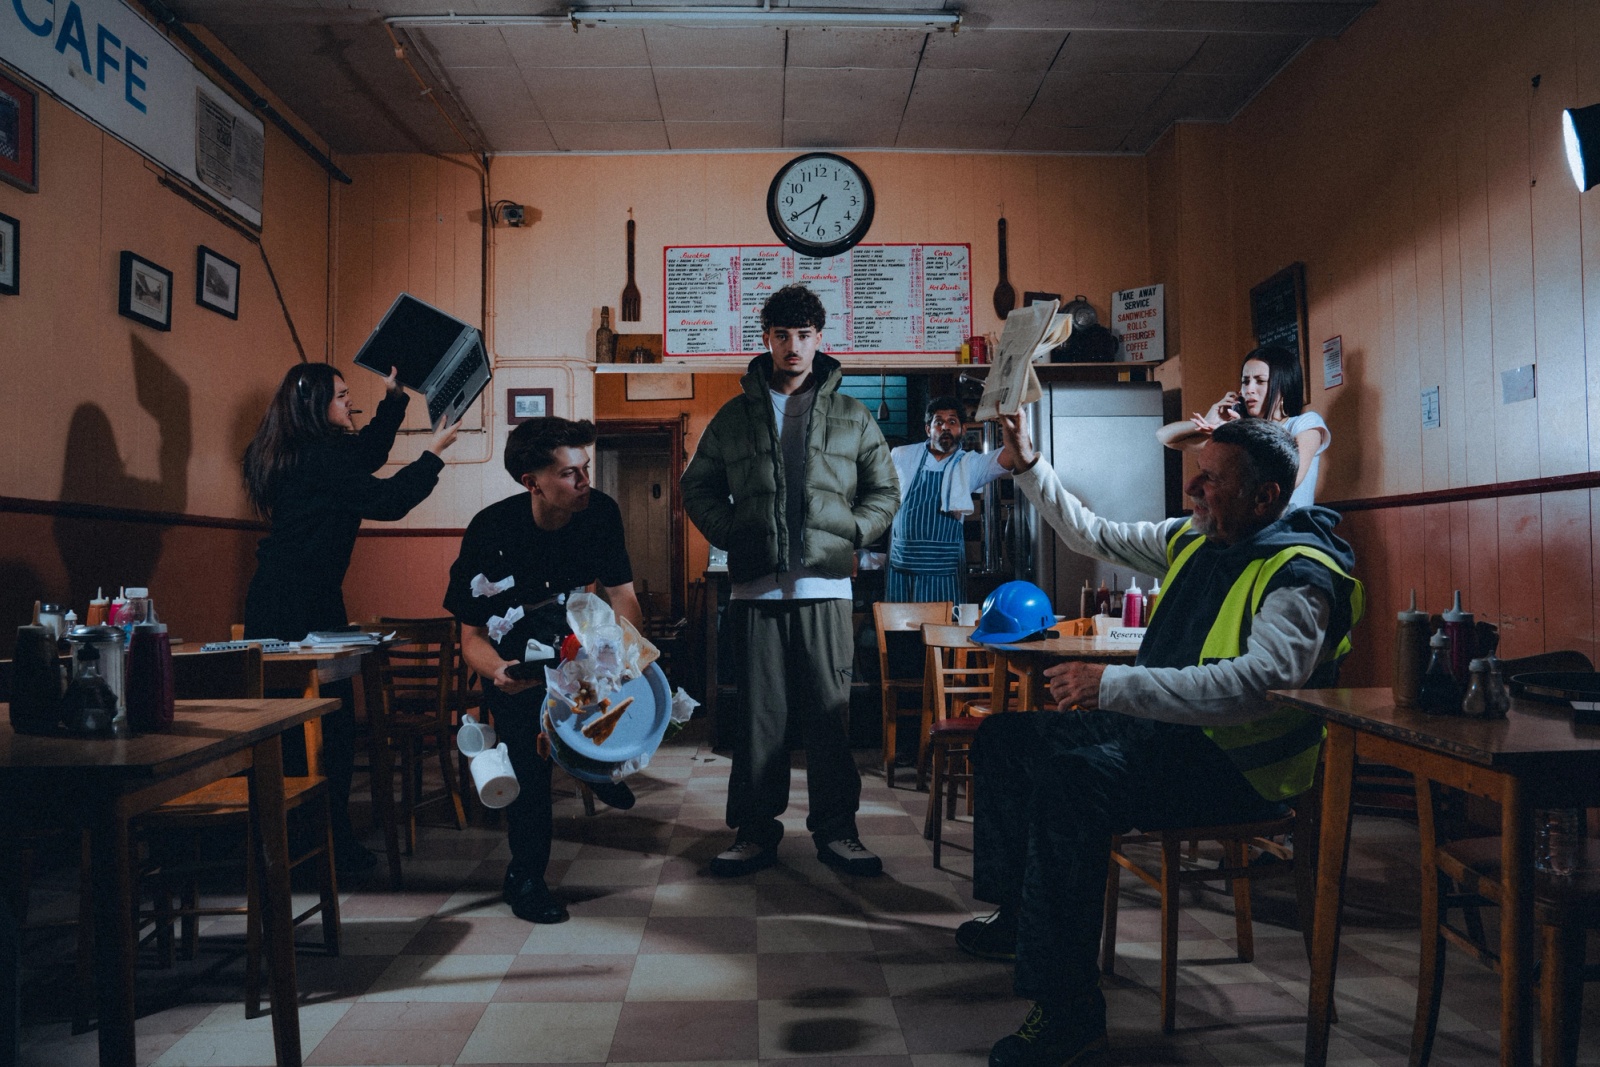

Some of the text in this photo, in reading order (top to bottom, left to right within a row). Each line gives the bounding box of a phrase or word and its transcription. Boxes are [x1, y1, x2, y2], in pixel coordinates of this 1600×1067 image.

[12, 0, 148, 115] CAFE
[802, 172, 812, 182] 11
[815, 167, 827, 178] 12
[834, 171, 838, 181] 1
[791, 183, 803, 194] 10
[843, 180, 851, 191] 2
[785, 196, 794, 207] 9
[850, 196, 857, 207] 3
[790, 211, 799, 222] 8
[843, 210, 852, 221] 4
[803, 222, 811, 233] 7
[816, 226, 826, 237] 6
[834, 221, 842, 232] 5
[1119, 287, 1157, 301] TAKE AWAY
[1125, 299, 1150, 310] SERVICE
[1118, 308, 1157, 322] SANDWICHES
[1127, 321, 1147, 331] ROLLS
[1126, 341, 1148, 352] COFFEE
[1131, 352, 1144, 360] TEA
[1110, 630, 1144, 639] Reserve
